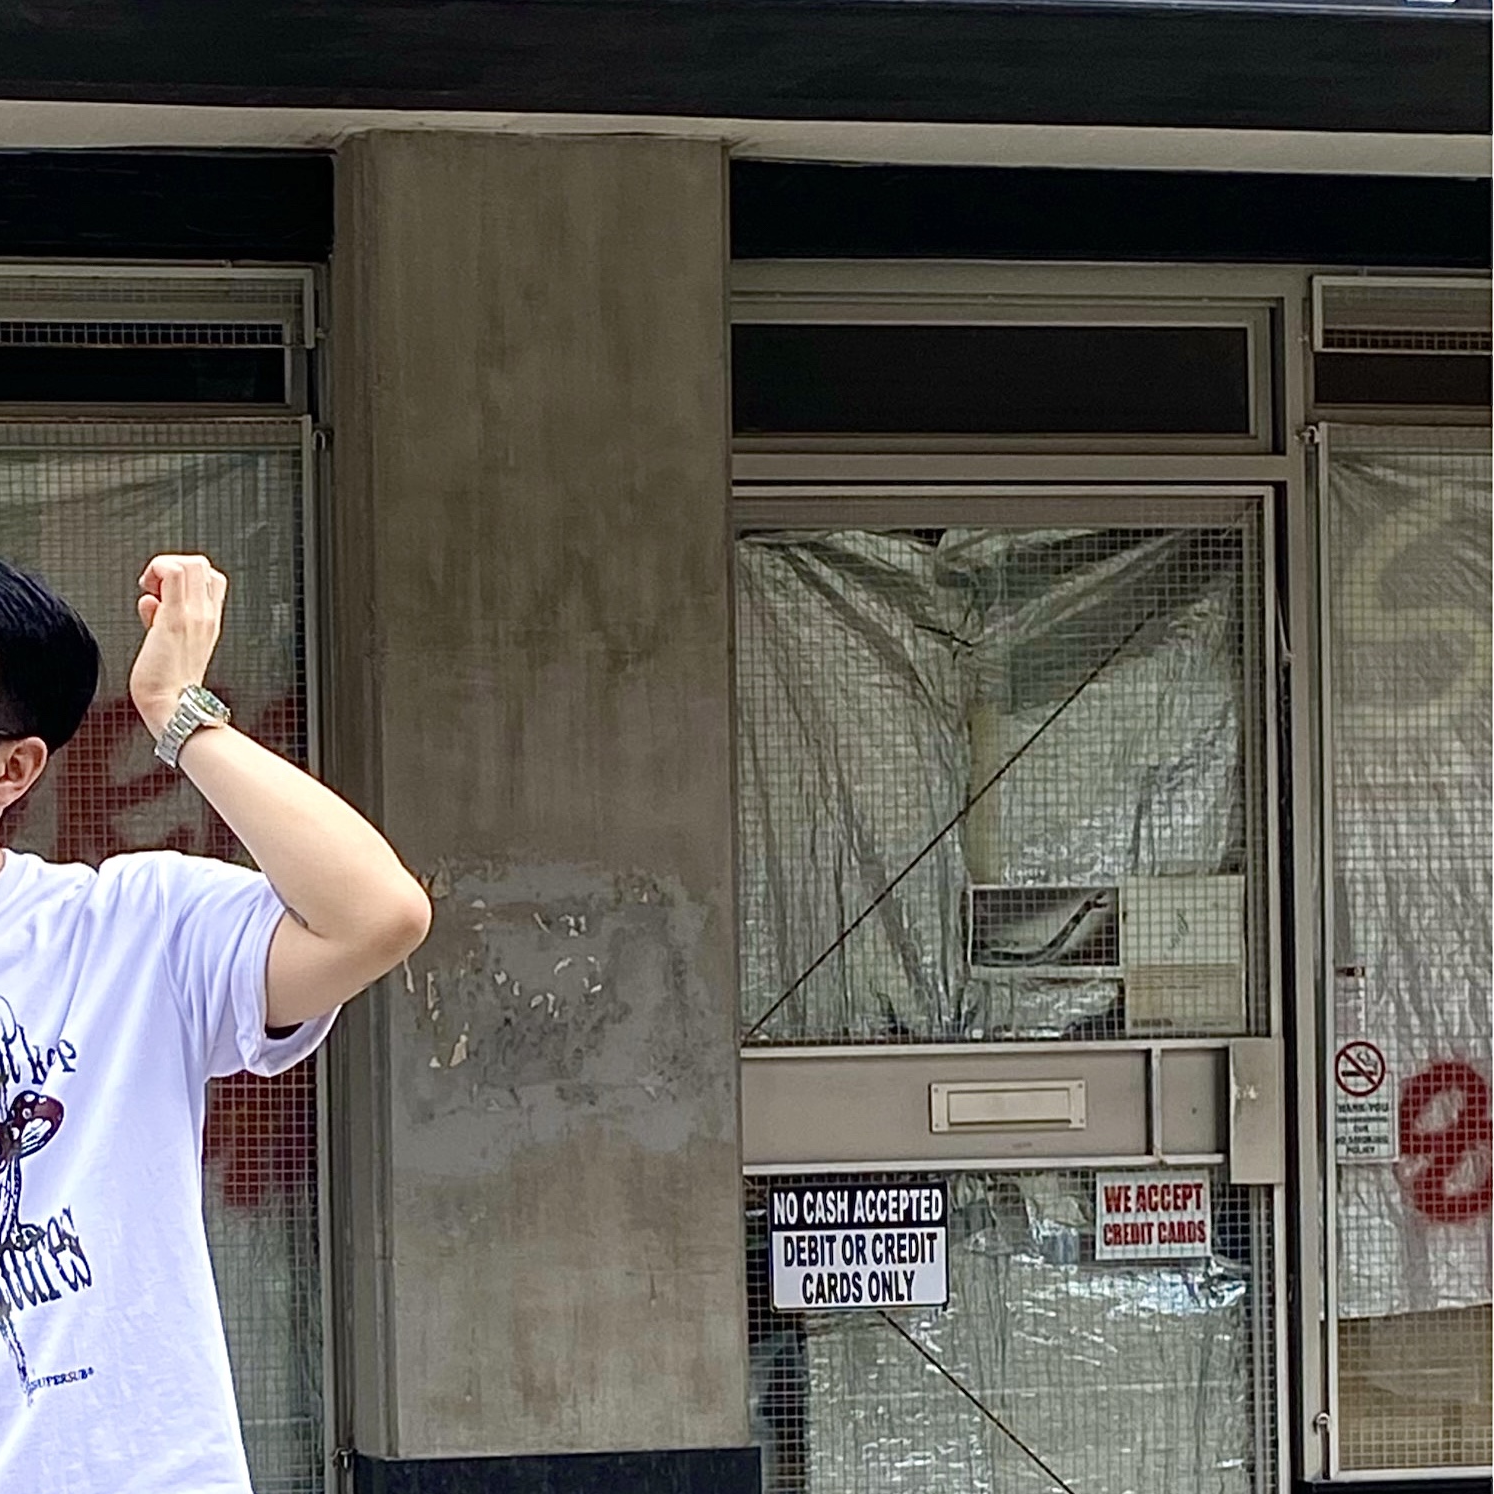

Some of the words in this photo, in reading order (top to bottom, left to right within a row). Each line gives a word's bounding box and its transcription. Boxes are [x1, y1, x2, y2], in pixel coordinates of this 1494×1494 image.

[773, 1192, 798, 1225] NO
[803, 1190, 849, 1224] CASH
[853, 1188, 943, 1223] ACCEPTED
[1104, 1185, 1132, 1213] WE
[1136, 1183, 1204, 1212] ACCEPT
[784, 1235, 837, 1267] DEBIT
[841, 1234, 867, 1266] OR
[872, 1232, 938, 1265] CREDIT
[1103, 1222, 1154, 1246] CREDIT
[1158, 1220, 1206, 1245] CARDS
[802, 1272, 863, 1305] CARDS
[867, 1270, 916, 1302] ONLY
